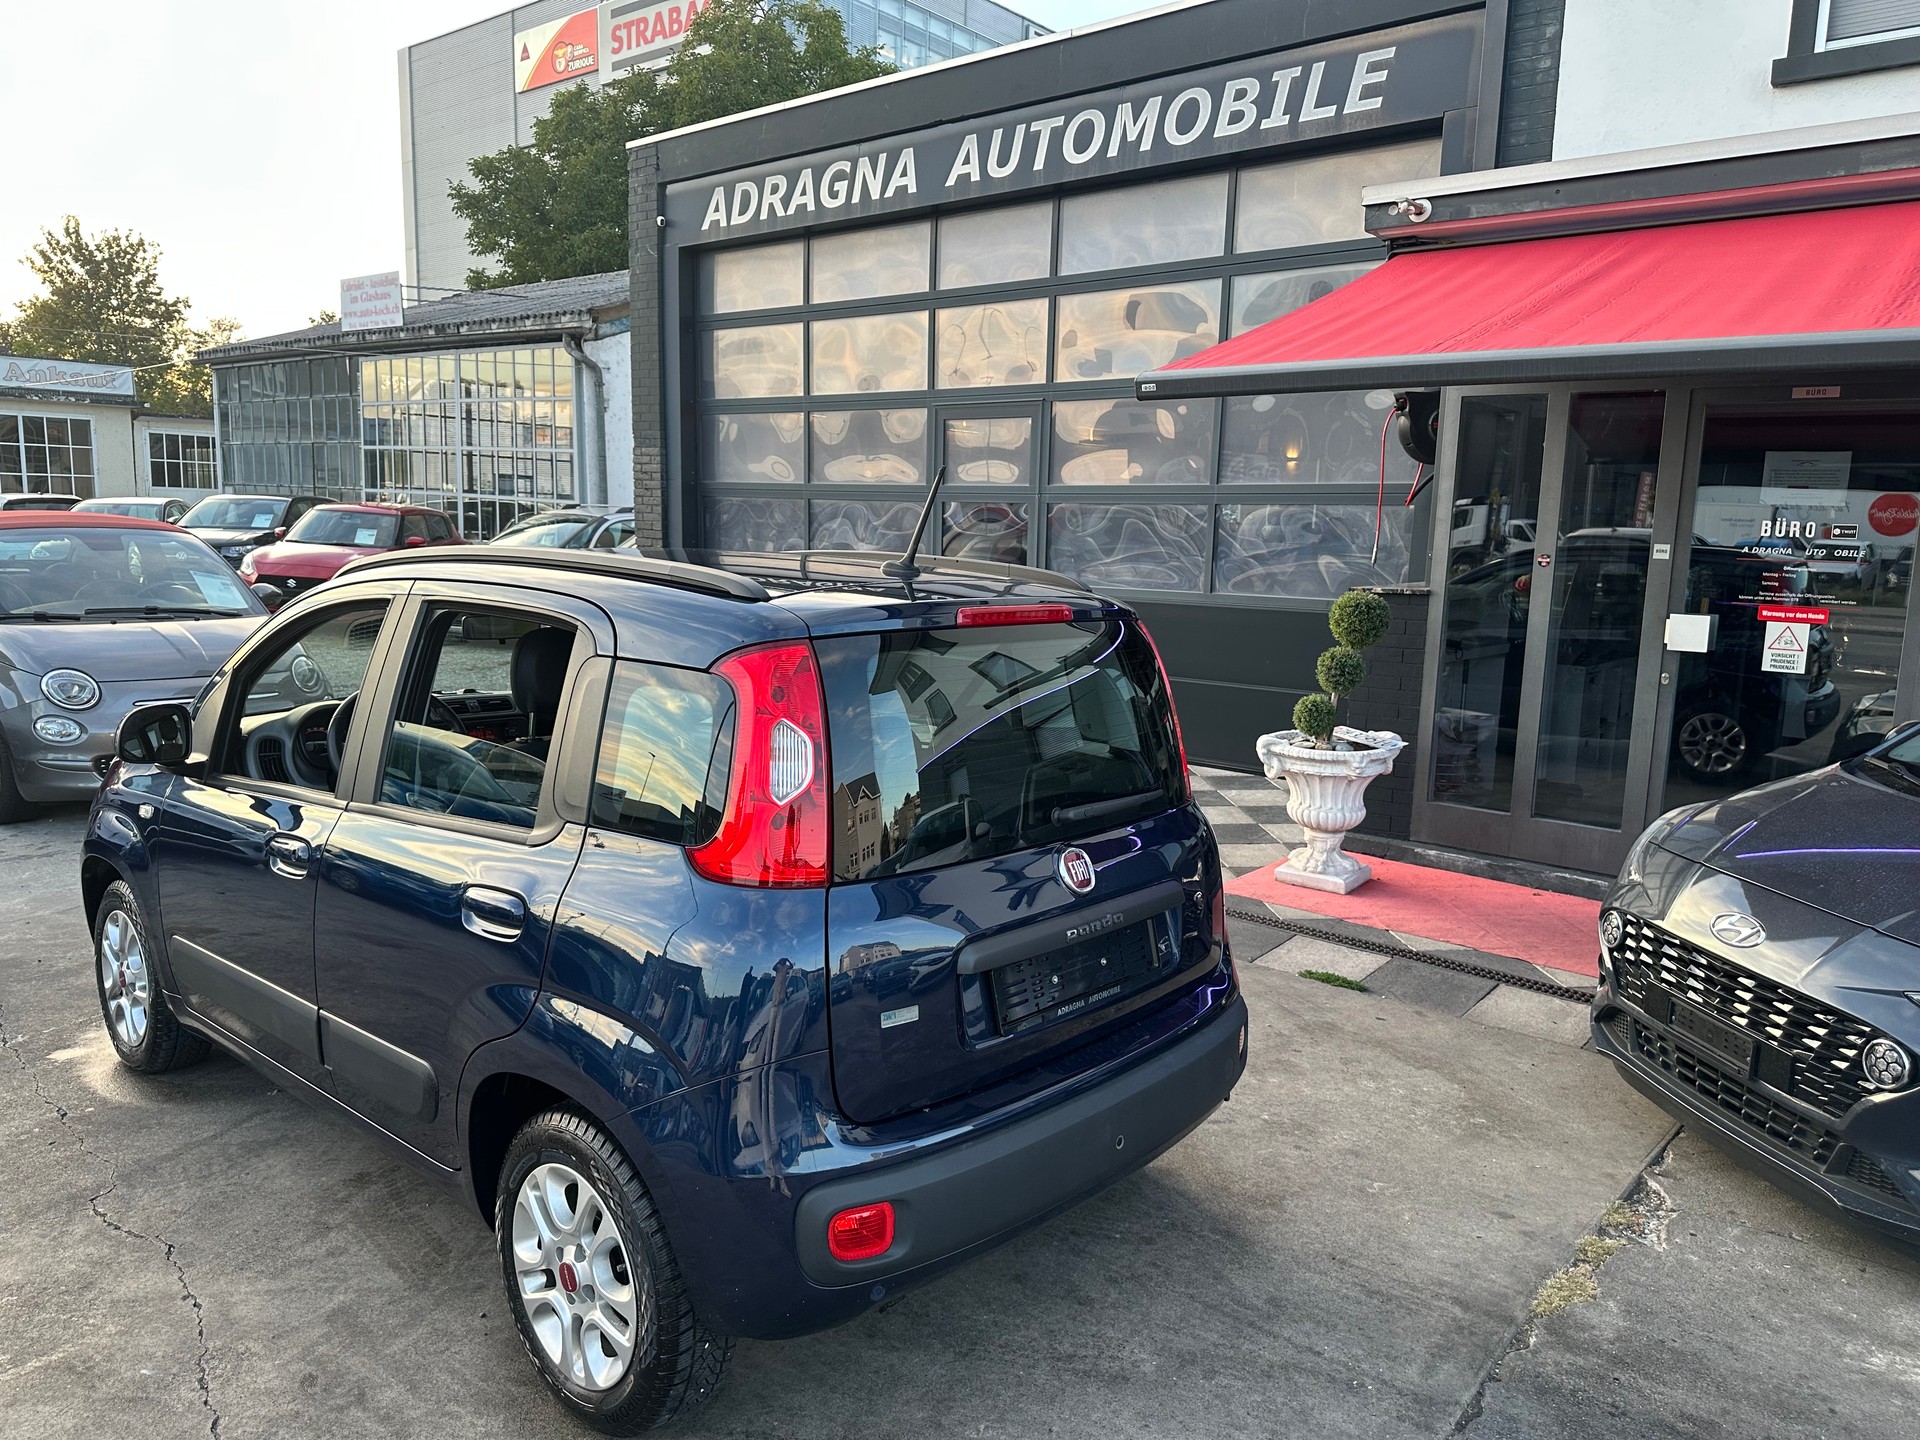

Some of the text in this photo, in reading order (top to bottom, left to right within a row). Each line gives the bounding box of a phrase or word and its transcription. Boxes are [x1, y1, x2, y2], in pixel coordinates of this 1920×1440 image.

[611, 0, 712, 55] STRABA
[568, 55, 595, 72] ZURIQUE
[701, 46, 1397, 231] ADRAGNA AUTOMOBILE
[350, 290, 391, 304] im Glashaus
[2, 361, 118, 389] Ankauf
[1805, 387, 1828, 396] BÜRO
[1760, 517, 1817, 538] BÜRO
[1805, 548, 1827, 556] UTO
[1834, 549, 1867, 558] OBILE
[1762, 610, 1785, 618] Warnung
[1067, 859, 1090, 883] FIAT
[1057, 984, 1121, 1017] ADRAGNA AUTOMOBILE
